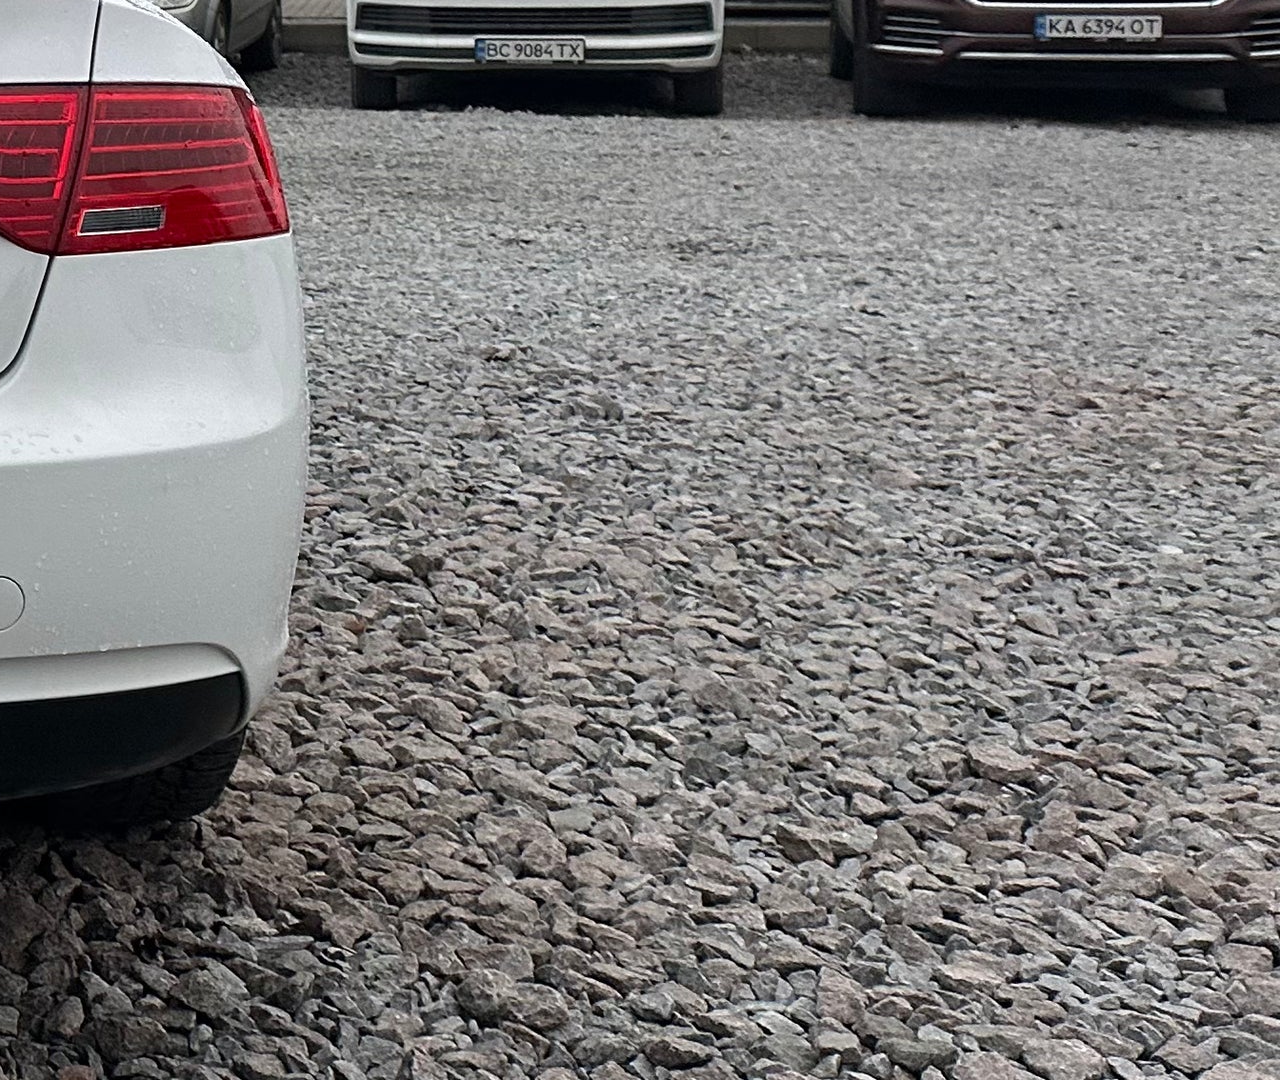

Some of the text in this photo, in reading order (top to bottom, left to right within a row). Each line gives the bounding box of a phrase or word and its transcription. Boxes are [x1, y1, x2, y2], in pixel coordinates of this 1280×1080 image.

[1048, 19, 1159, 34] KA 6394 OT
[486, 43, 581, 58] BC 9084 TX
